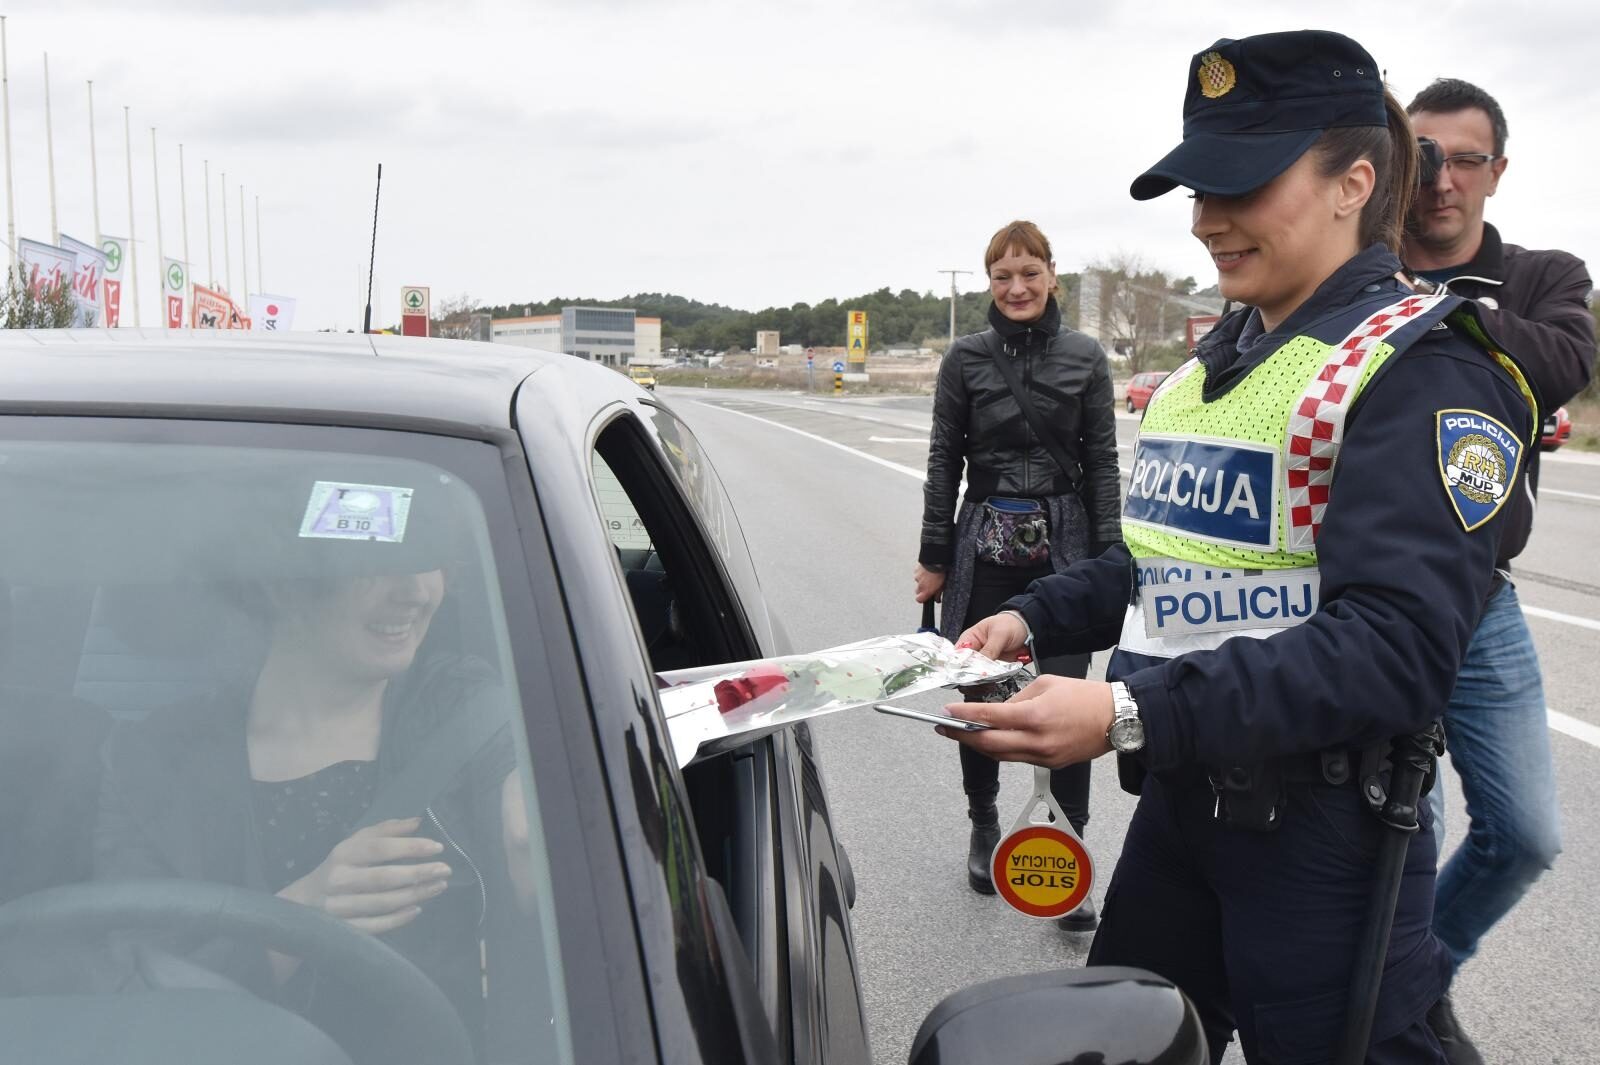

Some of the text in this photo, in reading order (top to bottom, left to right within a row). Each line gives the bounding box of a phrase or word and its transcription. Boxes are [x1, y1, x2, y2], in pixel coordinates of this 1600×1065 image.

[1445, 417, 1516, 458] POLICIJA
[1463, 451, 1495, 479] RH
[1129, 458, 1260, 520] POLICIJA
[1460, 472, 1493, 491] MUP
[1011, 854, 1075, 869] POLICIJA
[1011, 873, 1074, 888] STOP
